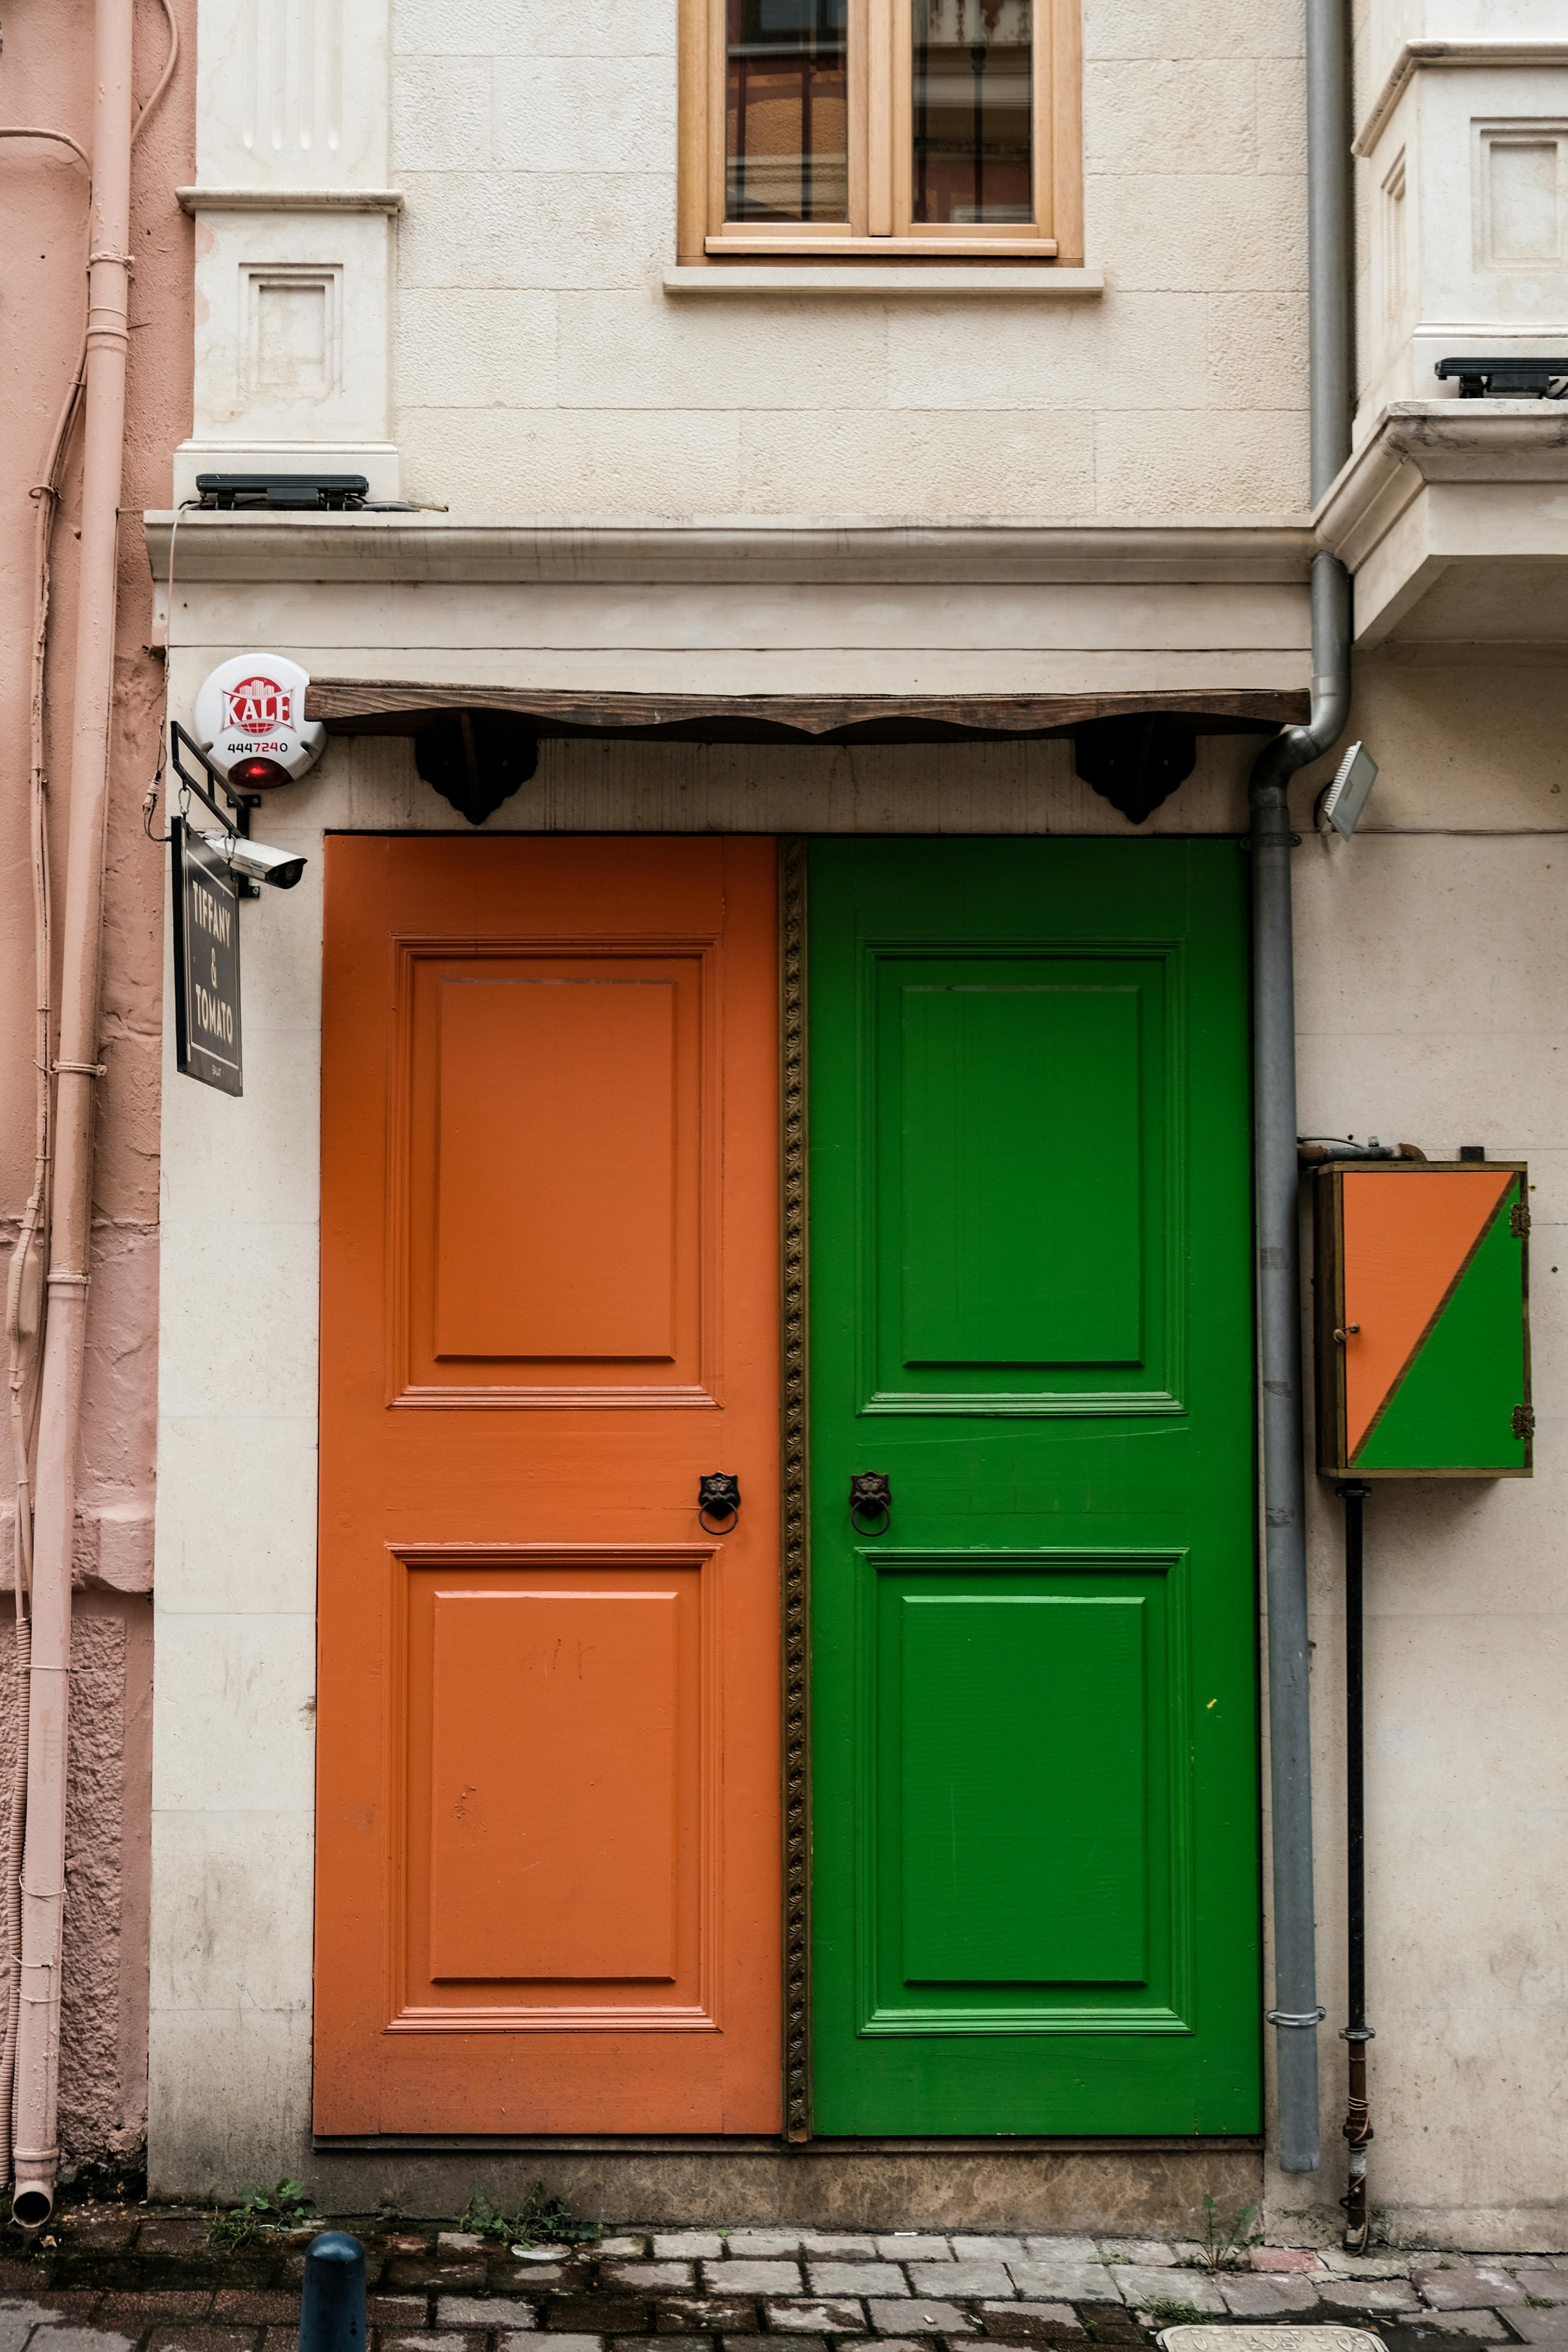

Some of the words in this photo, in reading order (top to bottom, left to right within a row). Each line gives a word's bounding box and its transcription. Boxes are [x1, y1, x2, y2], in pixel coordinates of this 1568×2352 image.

[223, 691, 292, 729] KALE
[192, 880, 230, 949] TIFFANY
[211, 947, 217, 989] &
[195, 983, 232, 1046] TOMATO
